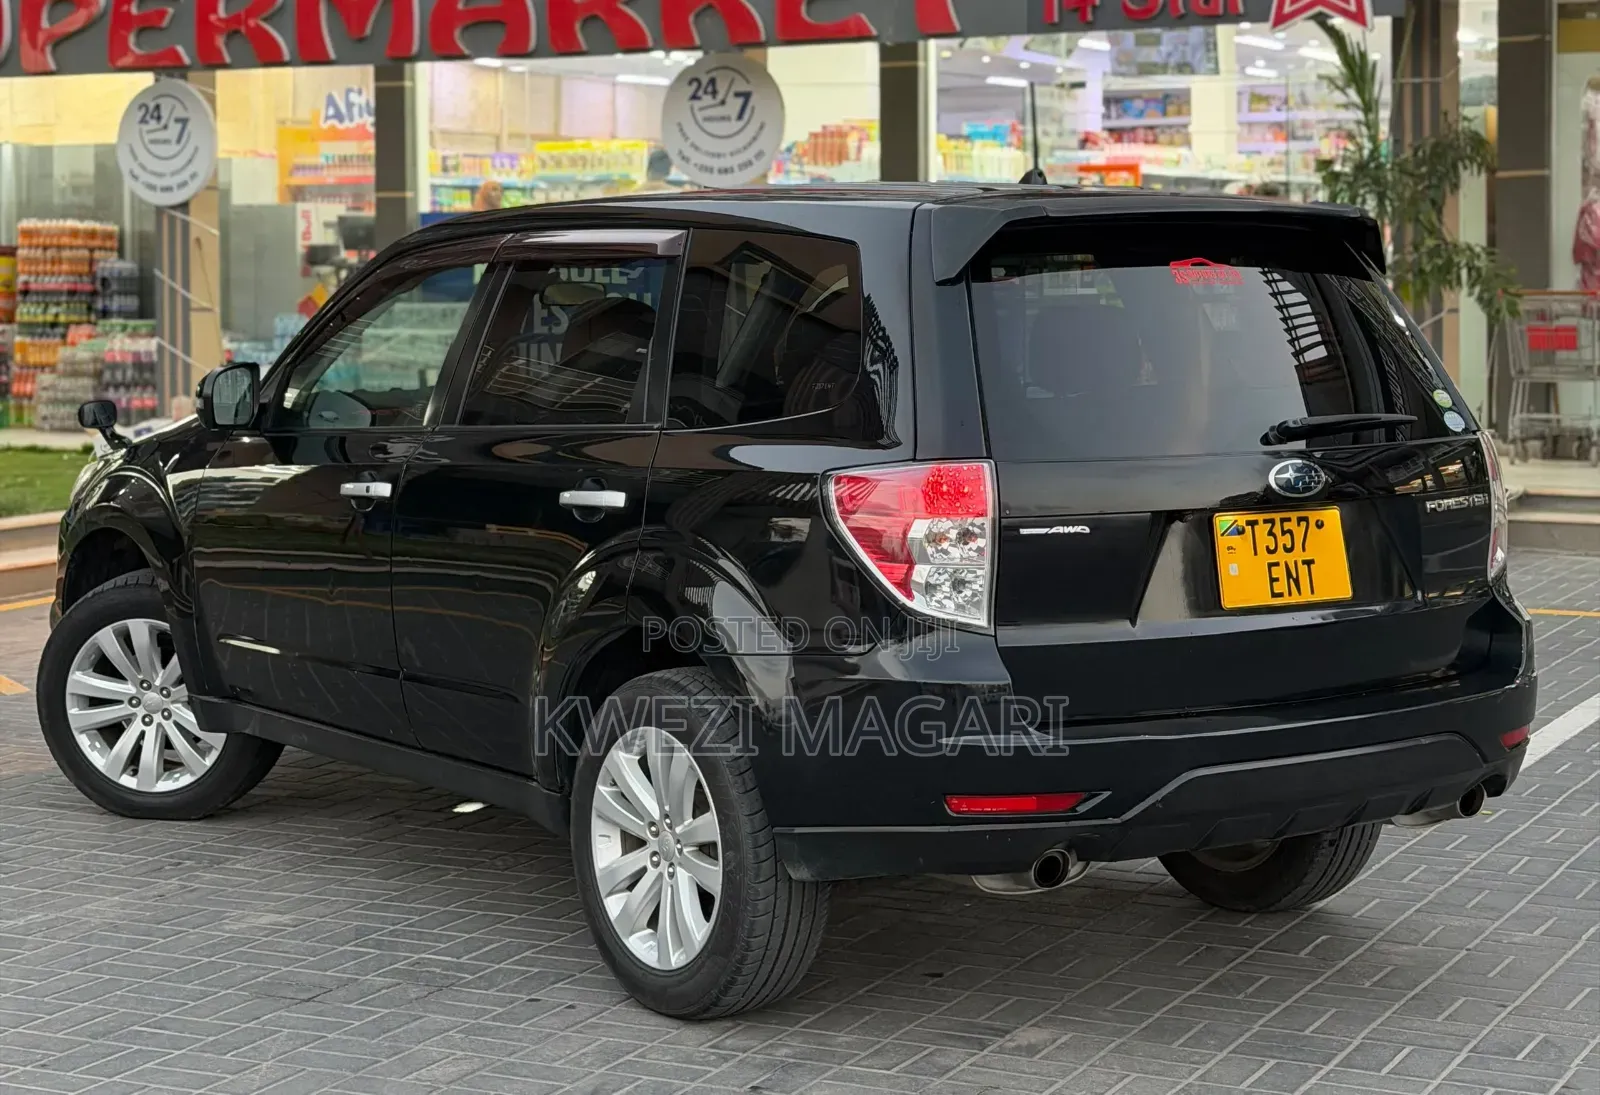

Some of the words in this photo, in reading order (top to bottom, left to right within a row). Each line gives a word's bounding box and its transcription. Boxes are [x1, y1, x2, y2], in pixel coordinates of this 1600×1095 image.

[1047, 525, 1091, 534] AWD
[1245, 516, 1310, 556] T357
[1267, 559, 1315, 599] ENT
